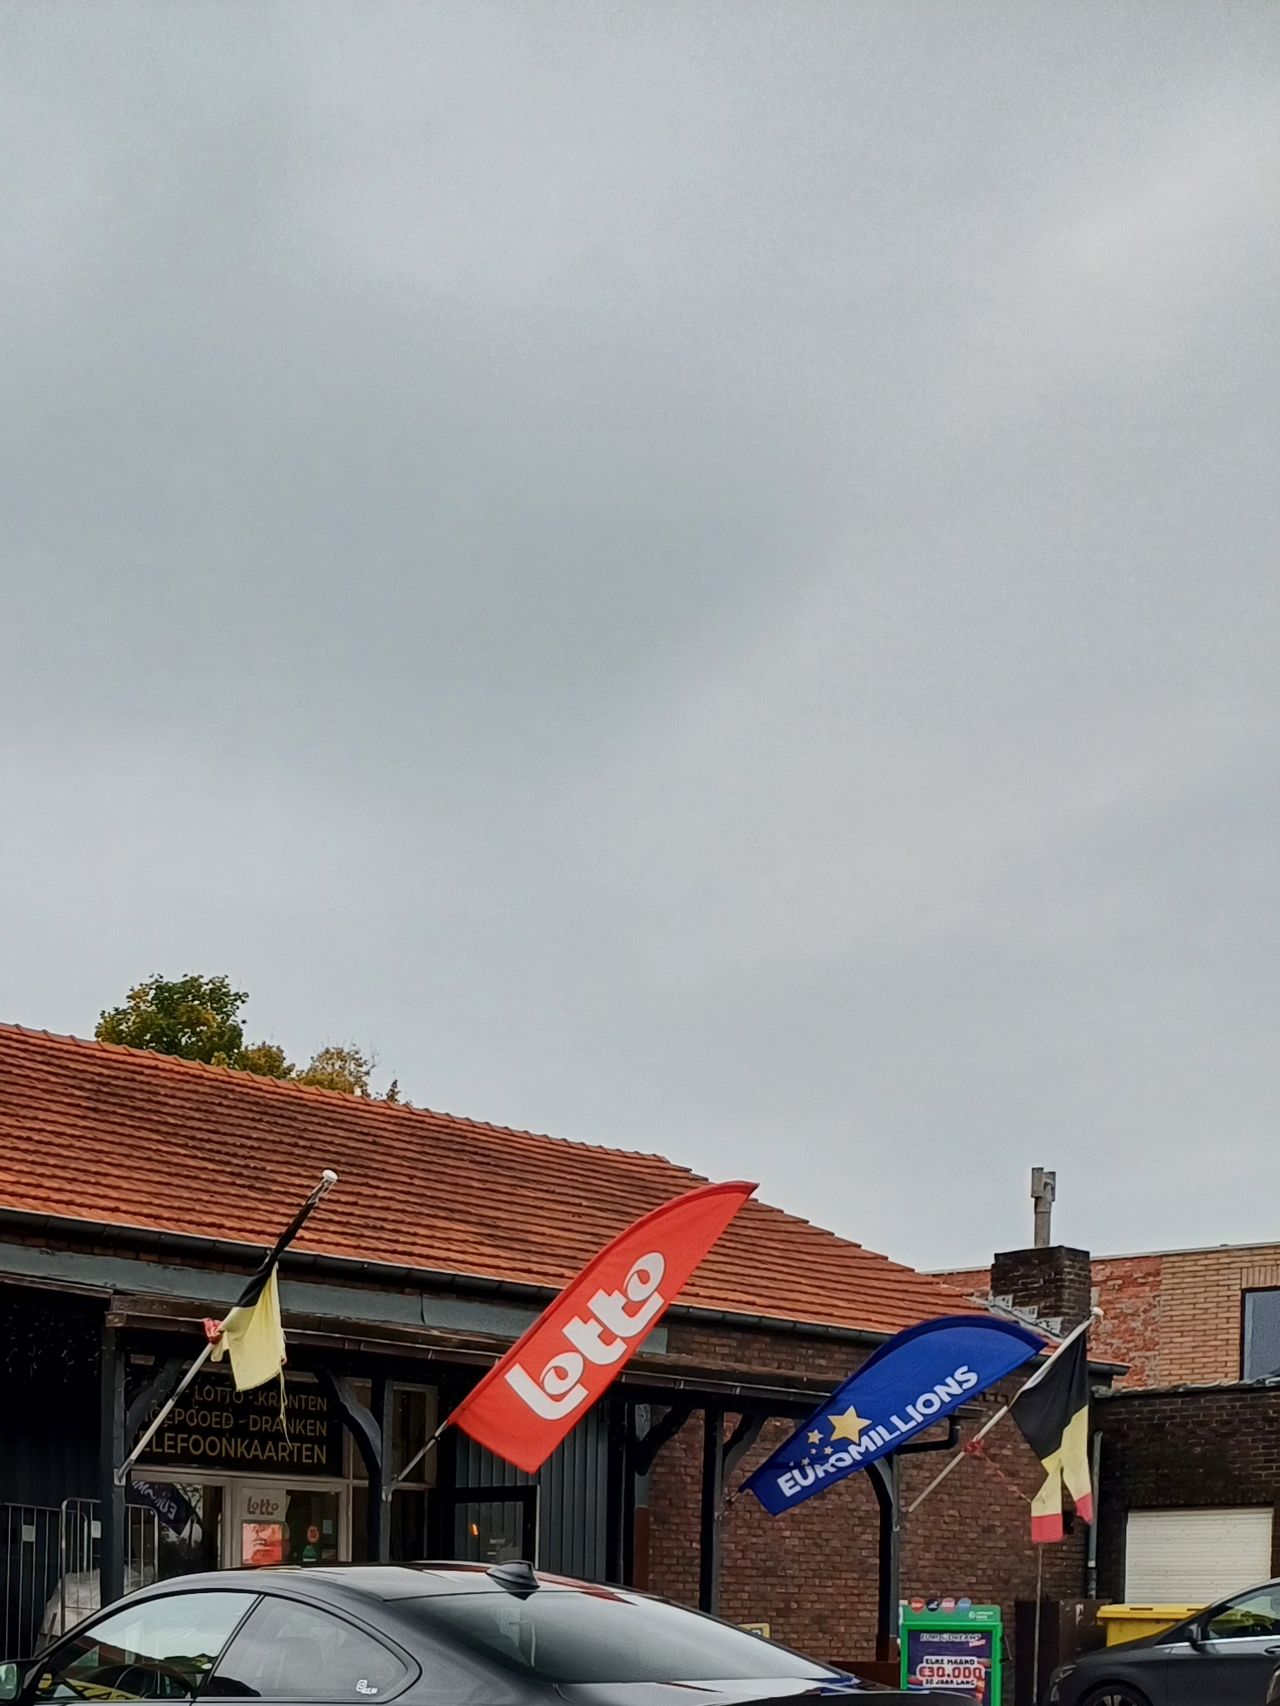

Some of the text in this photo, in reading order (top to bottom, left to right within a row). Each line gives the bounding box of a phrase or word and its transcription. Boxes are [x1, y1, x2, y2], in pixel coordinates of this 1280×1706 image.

[194, 1384, 244, 1405] LOTTO
[249, 1414, 327, 1437] DRANKEN
[776, 1365, 979, 1498] EUROMILLIONS
[138, 1429, 328, 1465] ELEFOONKAARTEN
